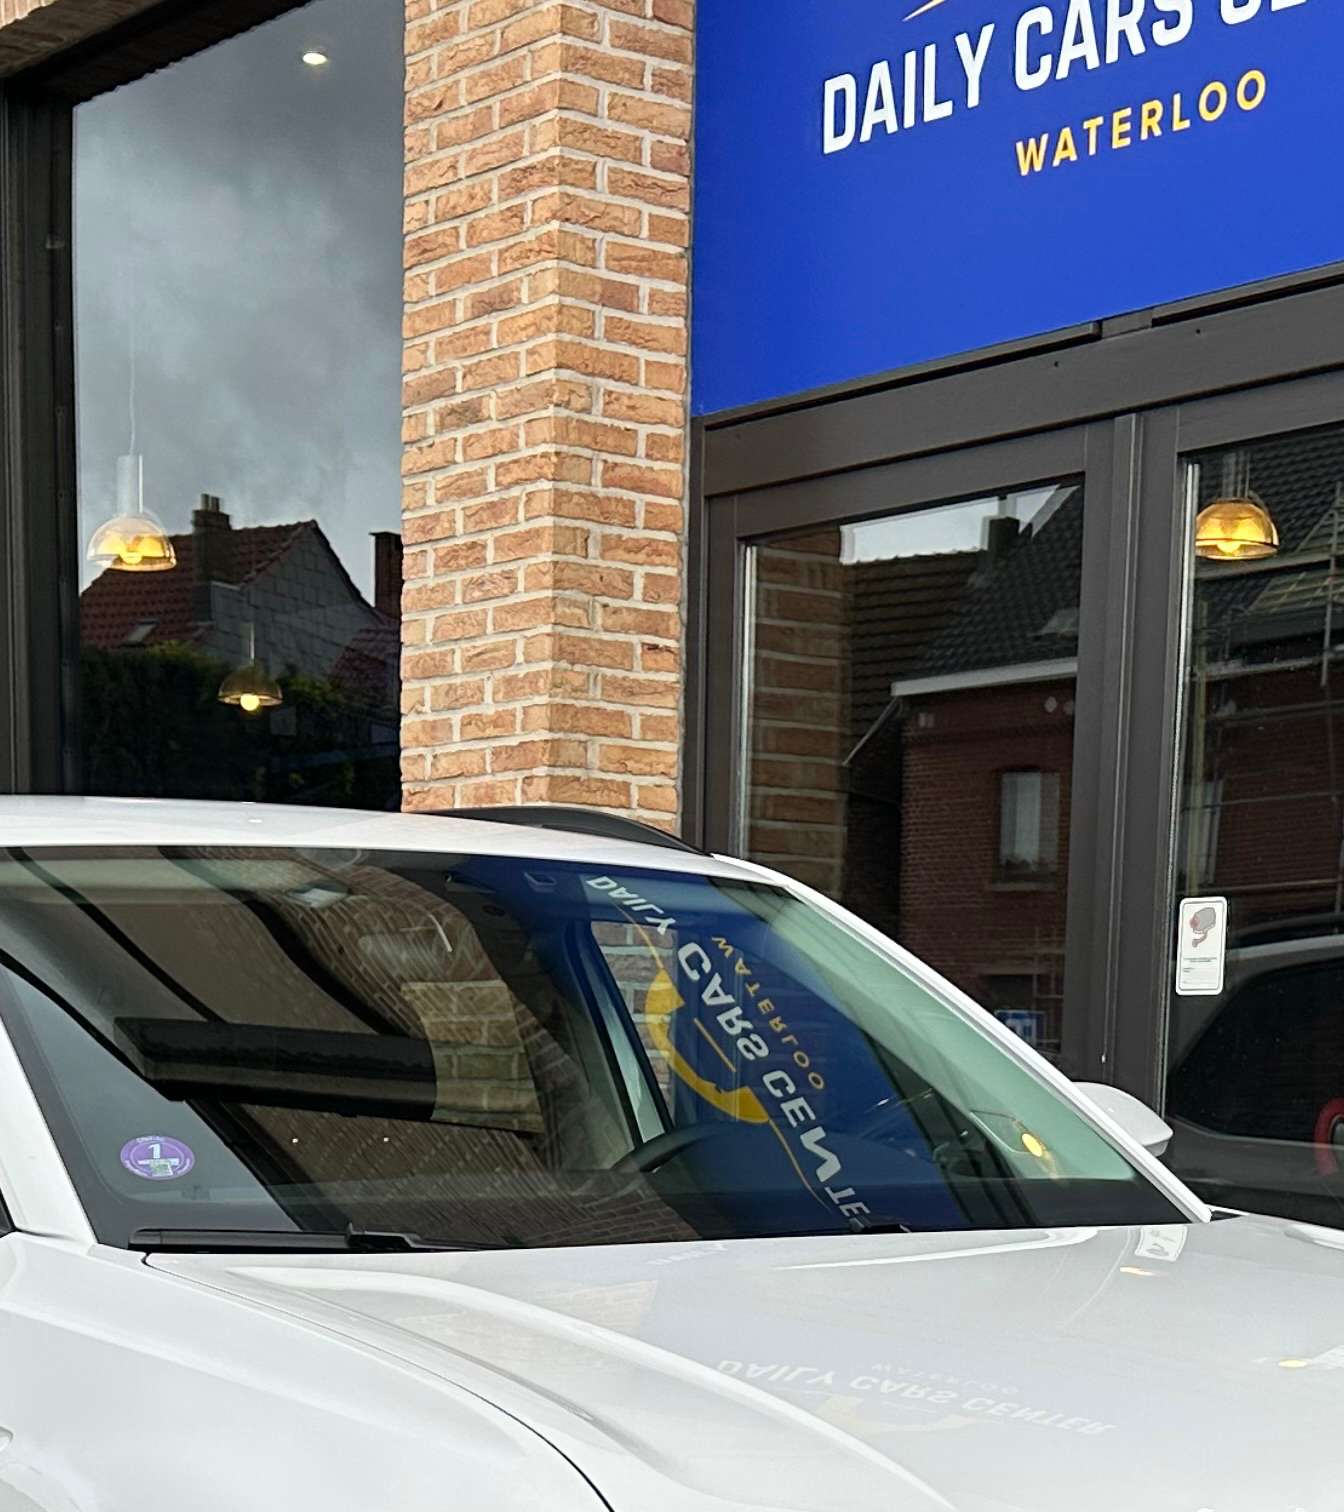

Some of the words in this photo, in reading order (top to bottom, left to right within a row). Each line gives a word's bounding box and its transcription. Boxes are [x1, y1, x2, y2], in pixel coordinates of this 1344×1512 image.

[823, 23, 996, 154] DAILY
[1014, 0, 1194, 91] CARS
[1015, 70, 1267, 176] WATERLOO
